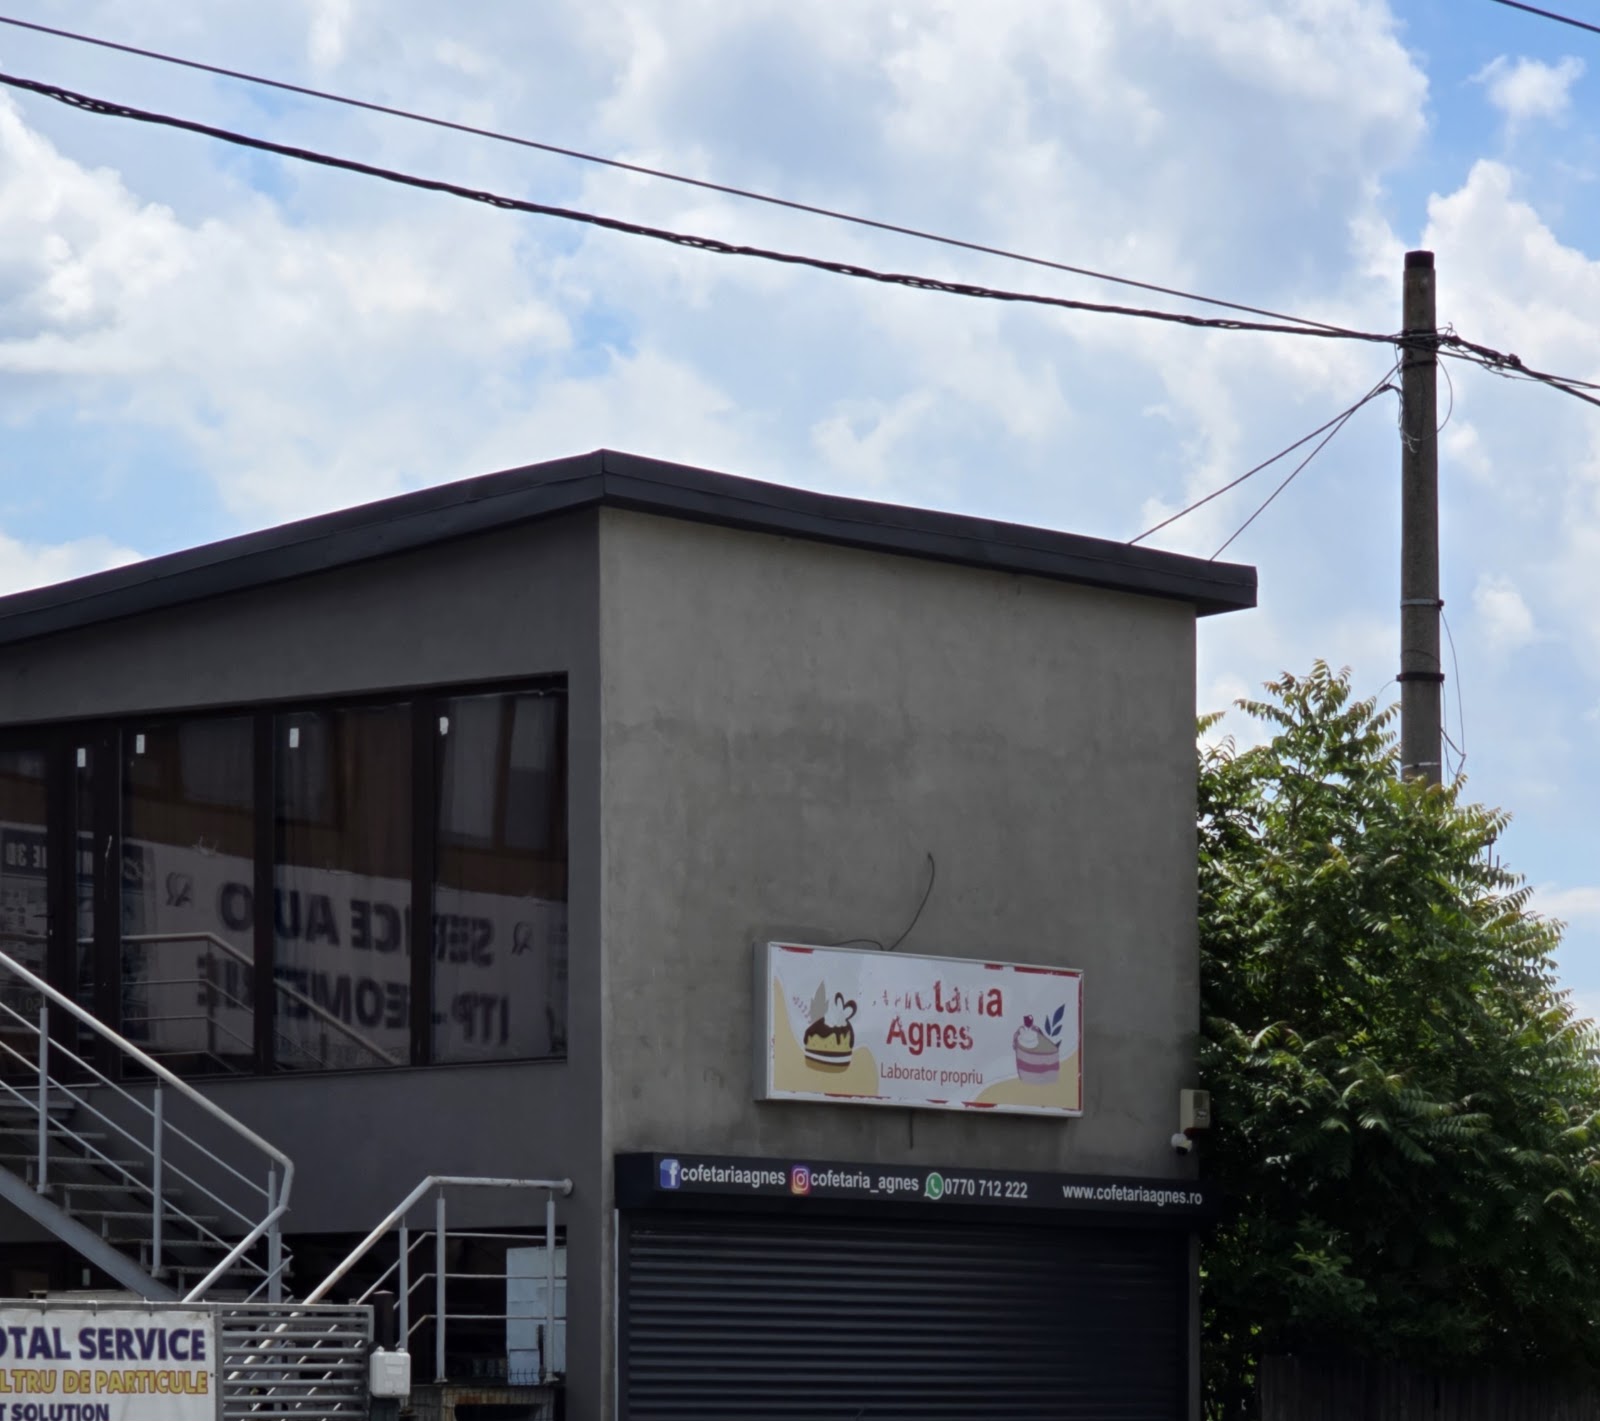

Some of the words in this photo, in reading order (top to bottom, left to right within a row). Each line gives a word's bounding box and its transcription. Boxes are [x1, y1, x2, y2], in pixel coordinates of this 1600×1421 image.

[886, 1016, 974, 1056] Agnes
[880, 1062, 938, 1081] Laborator
[940, 1069, 983, 1087] propriu
[680, 1164, 786, 1189] cofetariaagnes
[810, 1170, 919, 1194] cofetaria_agnes
[944, 1179, 975, 1196] 0770
[978, 1179, 1001, 1197] 712
[1004, 1181, 1028, 1199] 222
[1062, 1184, 1203, 1207] www.cofetariaagnes.ro
[78, 1327, 206, 1361] SERVICE
[62, 1369, 91, 1394] DE
[95, 1369, 209, 1394] PARTICULE
